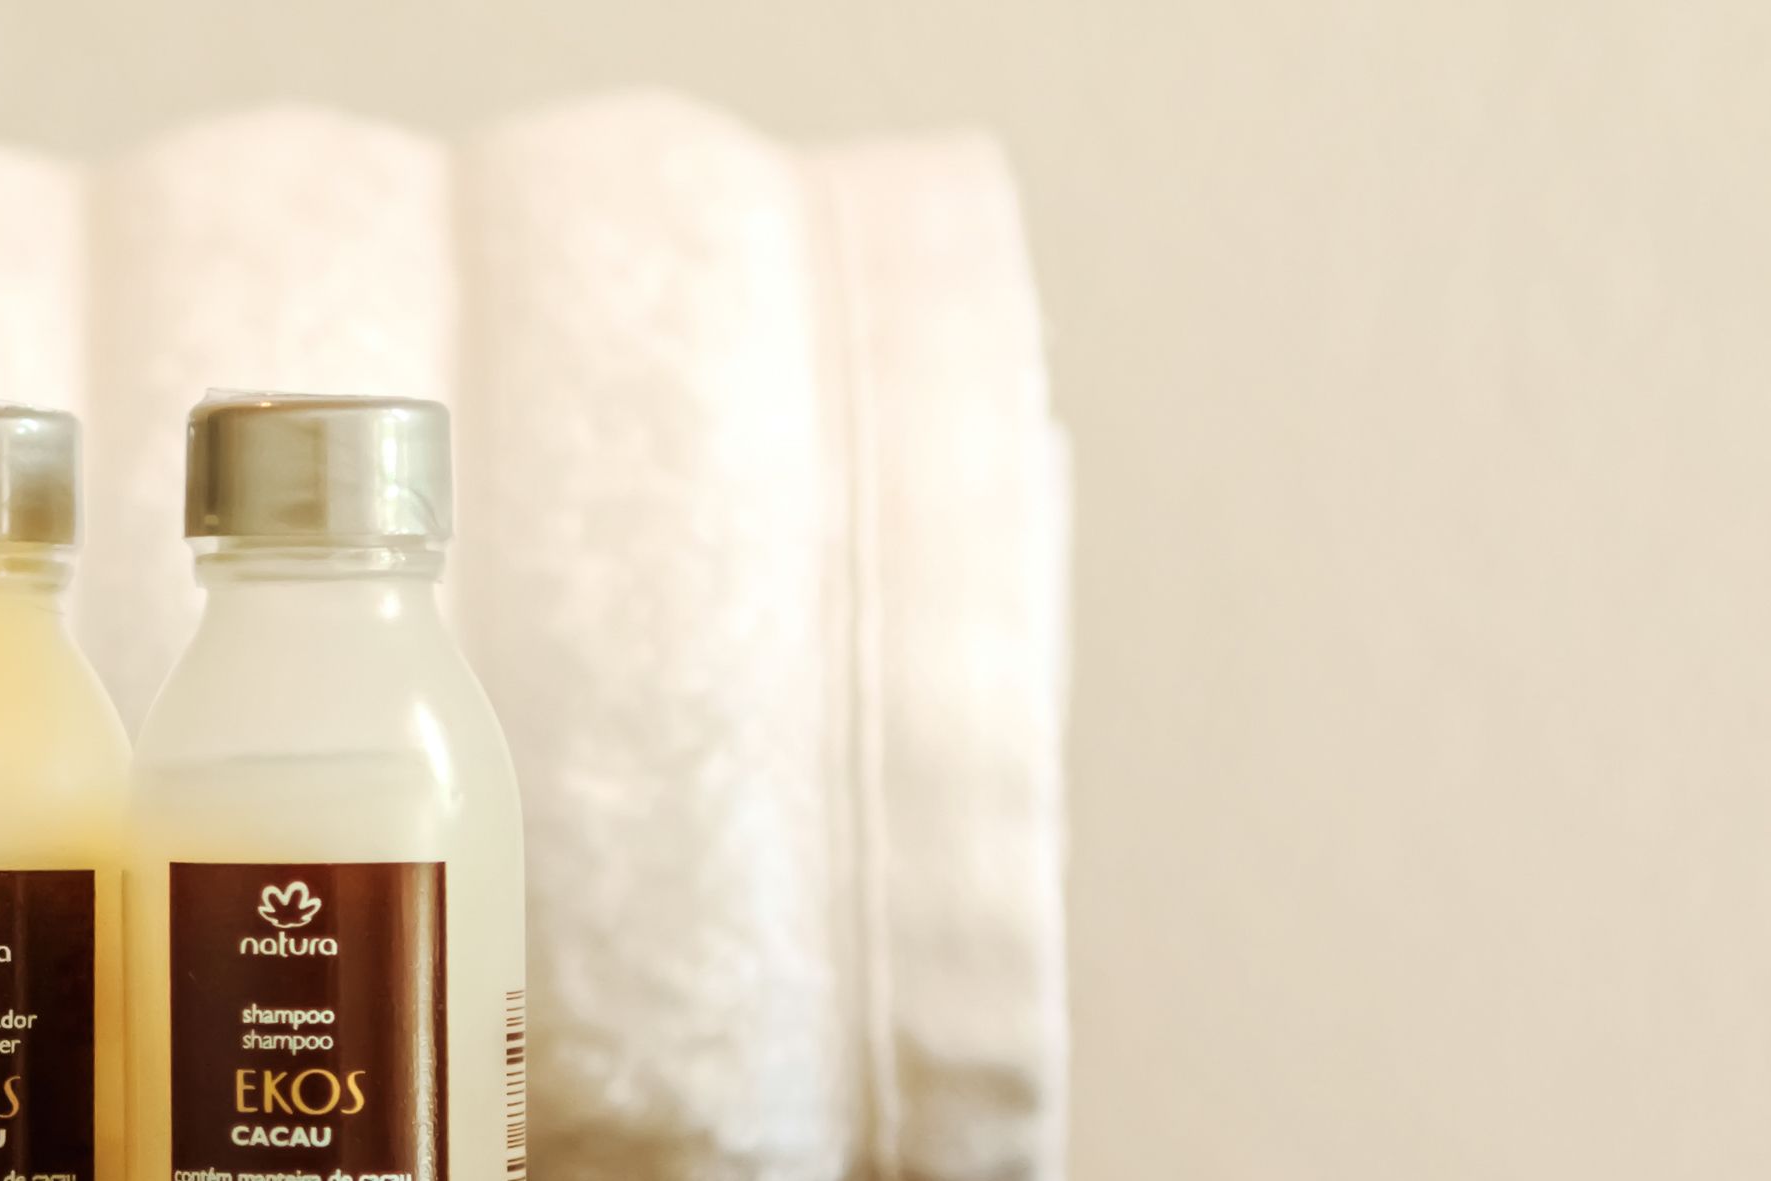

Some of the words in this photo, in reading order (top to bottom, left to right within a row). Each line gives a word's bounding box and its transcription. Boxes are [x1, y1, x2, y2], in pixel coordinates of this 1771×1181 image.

[240, 932, 337, 957] natura
[242, 1004, 335, 1029] shampoo
[242, 1030, 333, 1055] shampoo
[236, 1068, 366, 1115] EKOS
[231, 1126, 332, 1147] CACAU
